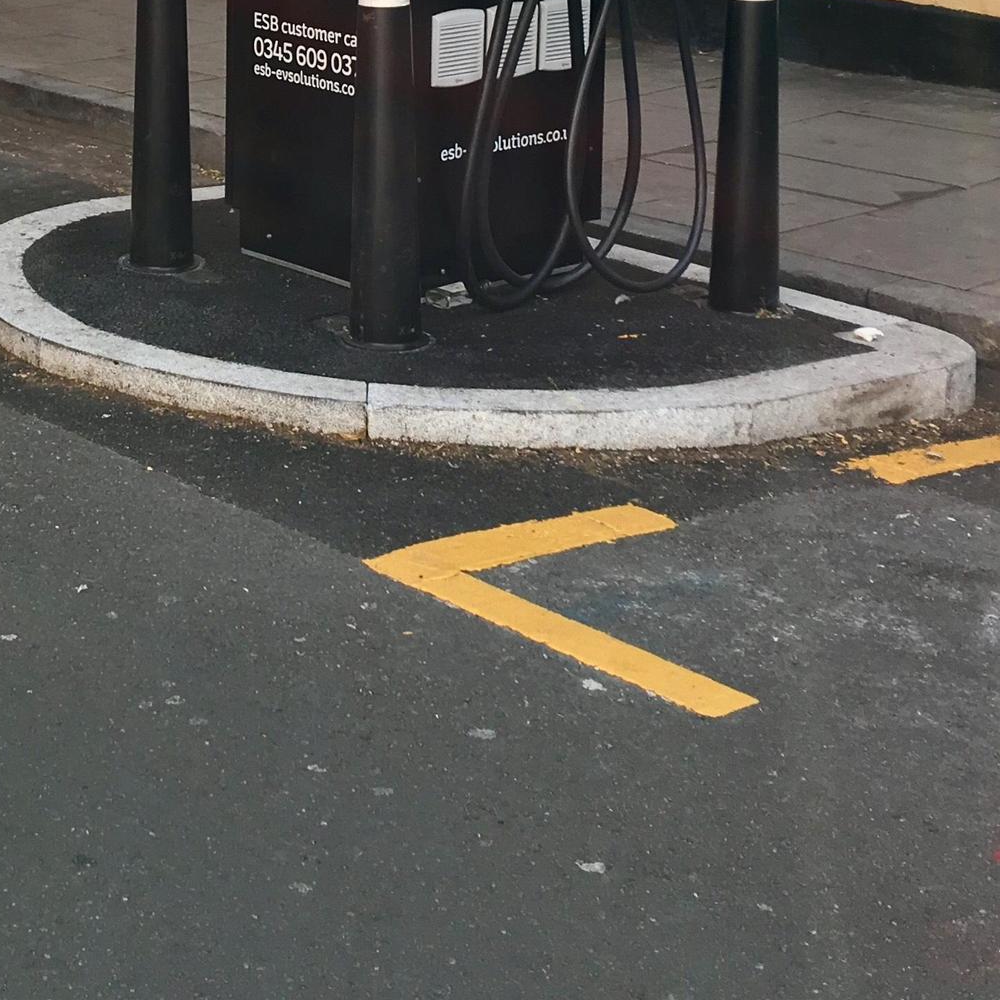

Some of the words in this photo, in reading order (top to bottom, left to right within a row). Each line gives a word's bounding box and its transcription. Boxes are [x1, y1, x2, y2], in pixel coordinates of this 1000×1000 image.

[254, 12, 279, 32] ESB
[281, 21, 341, 44] customer
[344, 34, 358, 48] ca
[253, 36, 293, 63] 0345
[295, 45, 327, 70] 609
[253, 62, 355, 96] esb-evsolutions.co
